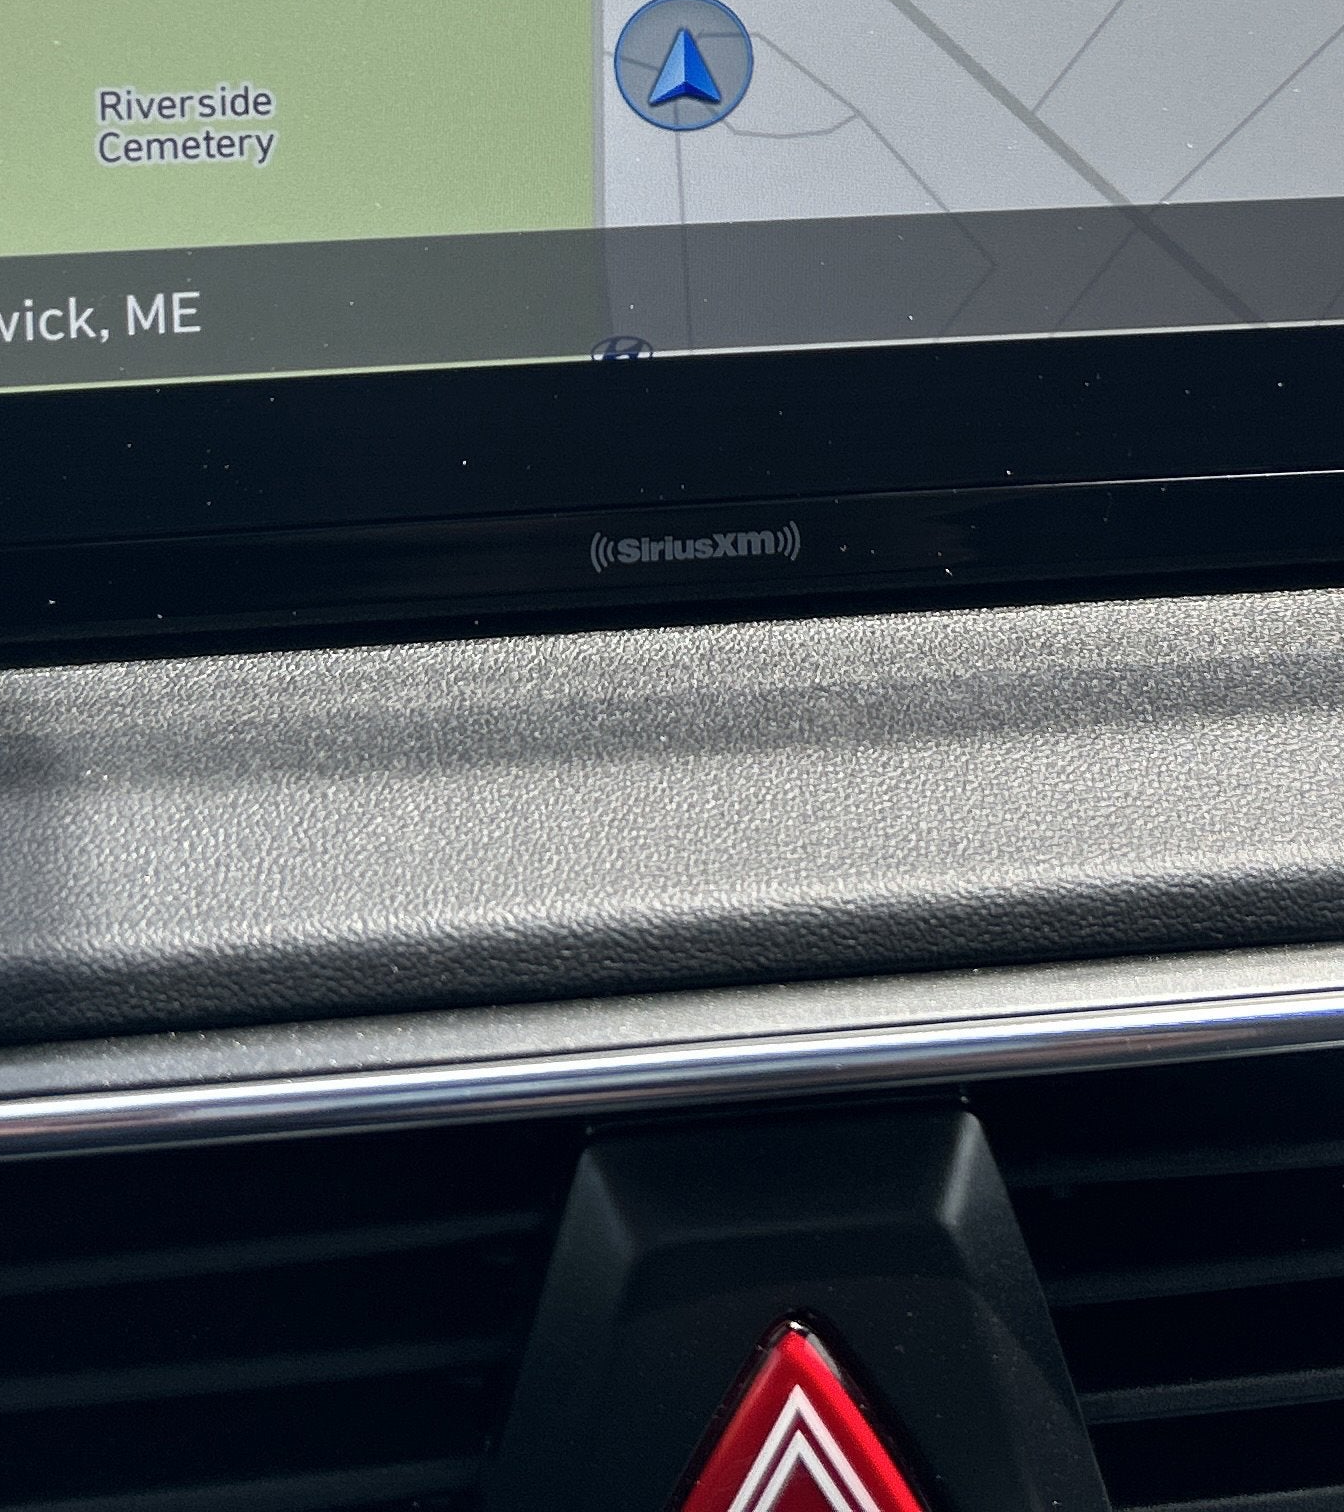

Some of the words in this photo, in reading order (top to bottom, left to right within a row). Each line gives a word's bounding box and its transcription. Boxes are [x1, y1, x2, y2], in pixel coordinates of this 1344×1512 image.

[98, 85, 273, 121] Riverside
[97, 129, 275, 164] Cemetery
[126, 291, 202, 337] ME
